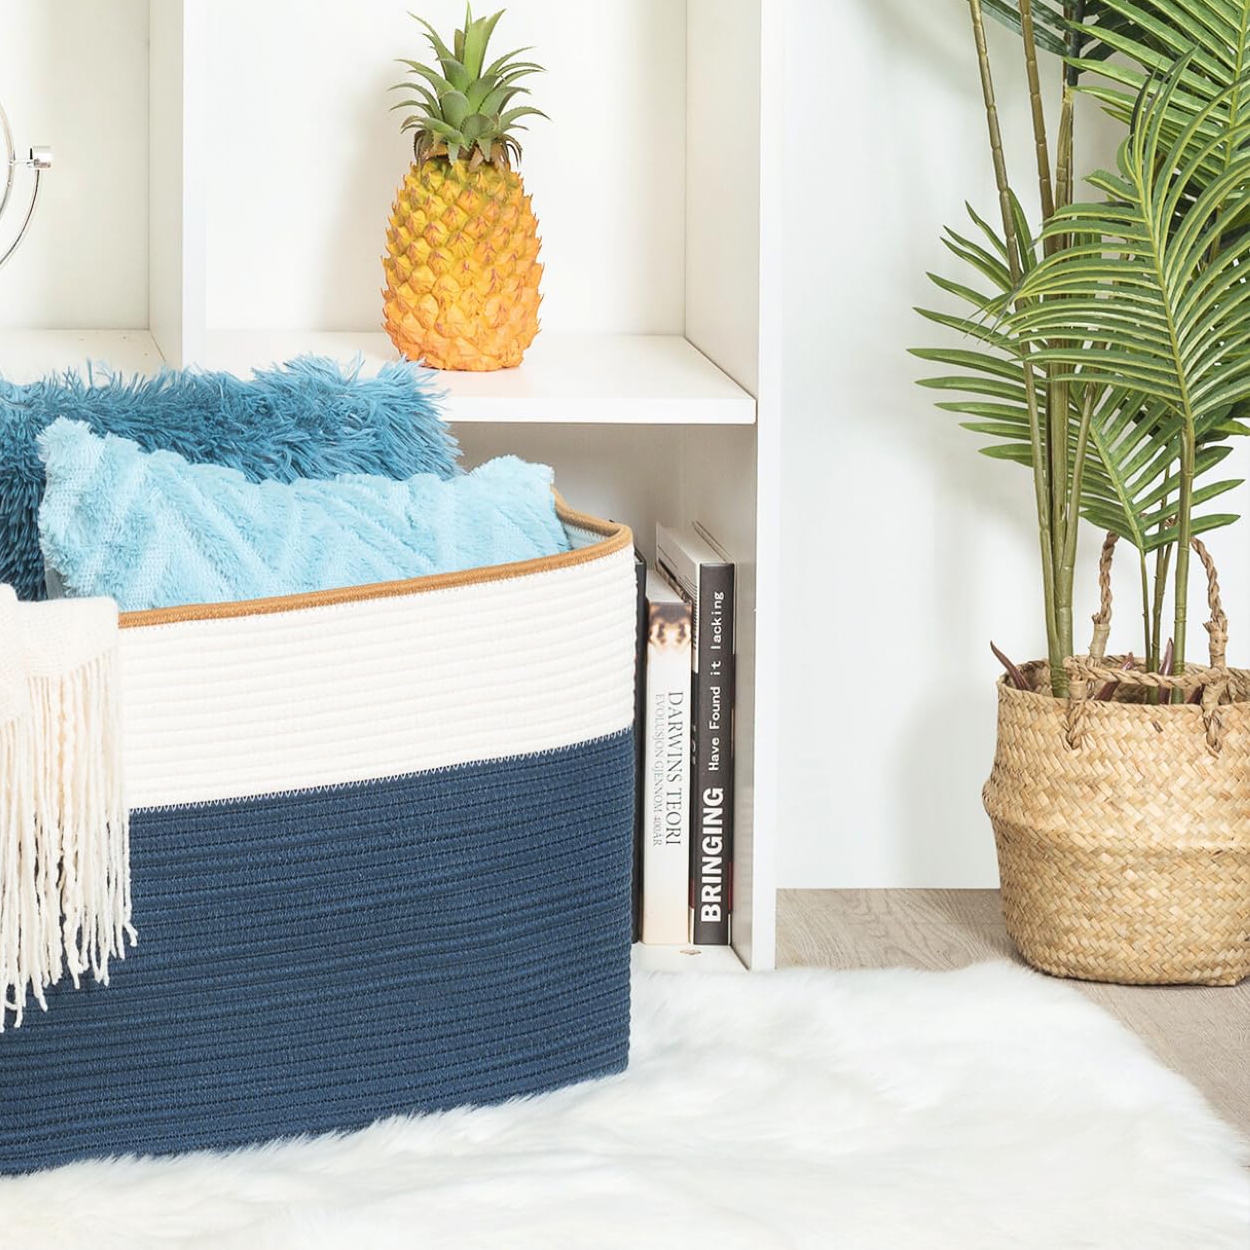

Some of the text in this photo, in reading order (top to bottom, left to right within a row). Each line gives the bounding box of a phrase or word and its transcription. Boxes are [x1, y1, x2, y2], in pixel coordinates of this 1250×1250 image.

[654, 694, 665, 757] EVOLUSJON
[708, 592, 724, 771] Have Found it lacking
[652, 761, 664, 812] GJENNOM
[665, 692, 683, 845] DARWINS TEORI
[701, 786, 725, 923] BRINGING
